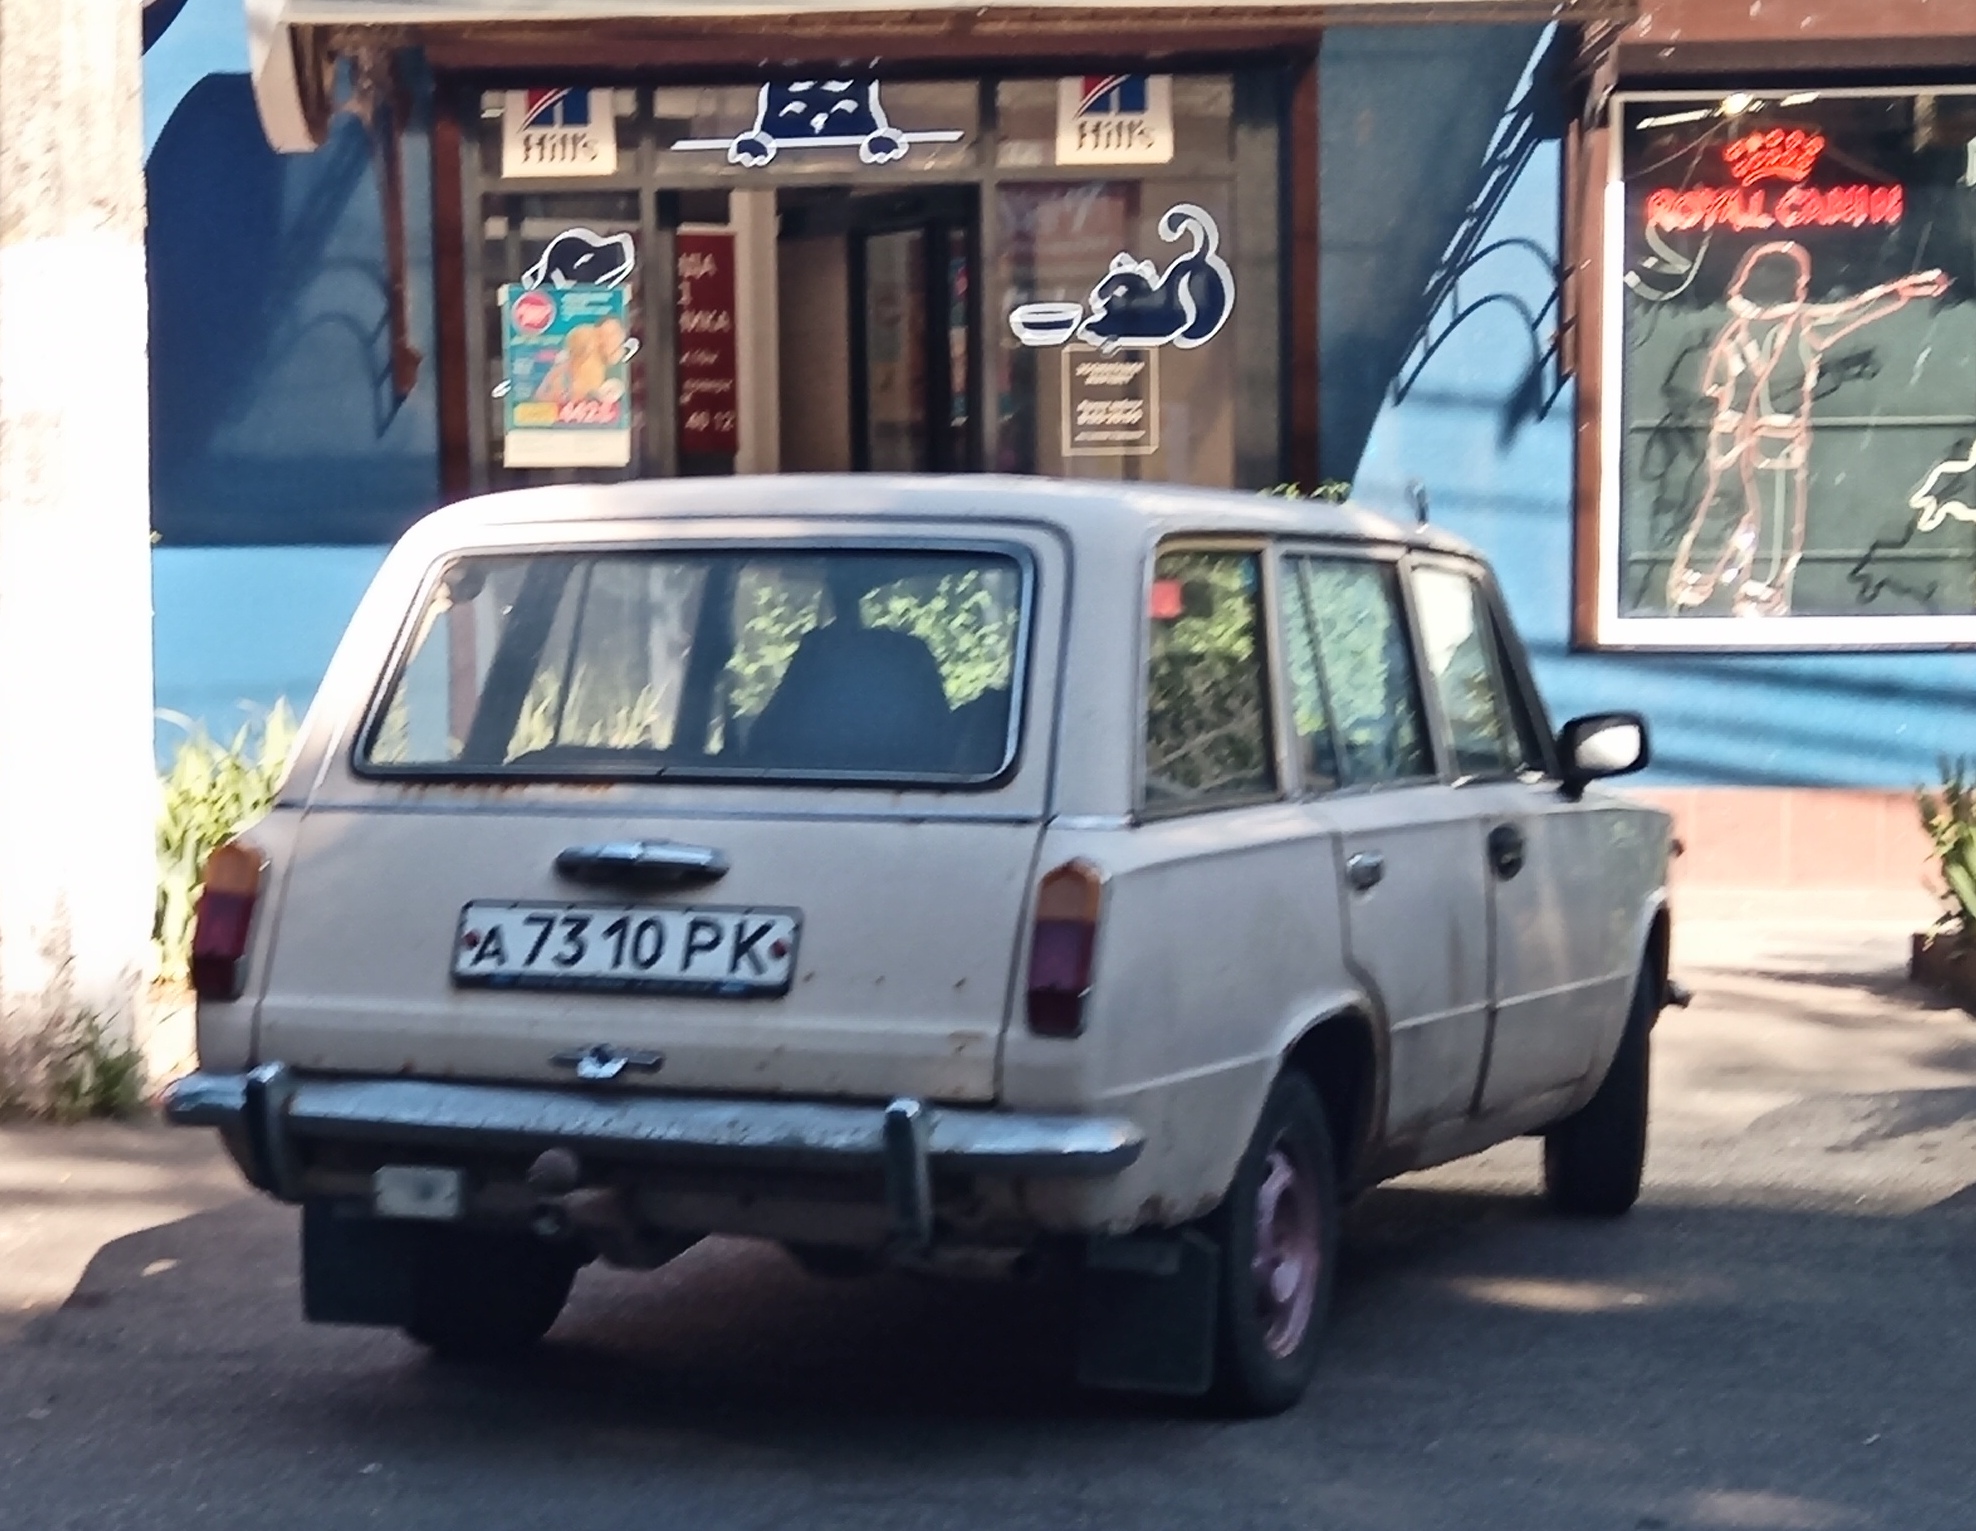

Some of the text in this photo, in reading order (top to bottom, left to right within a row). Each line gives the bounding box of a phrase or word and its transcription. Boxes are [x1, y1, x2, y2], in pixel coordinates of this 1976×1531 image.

[522, 133, 599, 163] Hill's
[1076, 120, 1155, 150] Hill's
[1646, 184, 1903, 231] ROYAL CANIN
